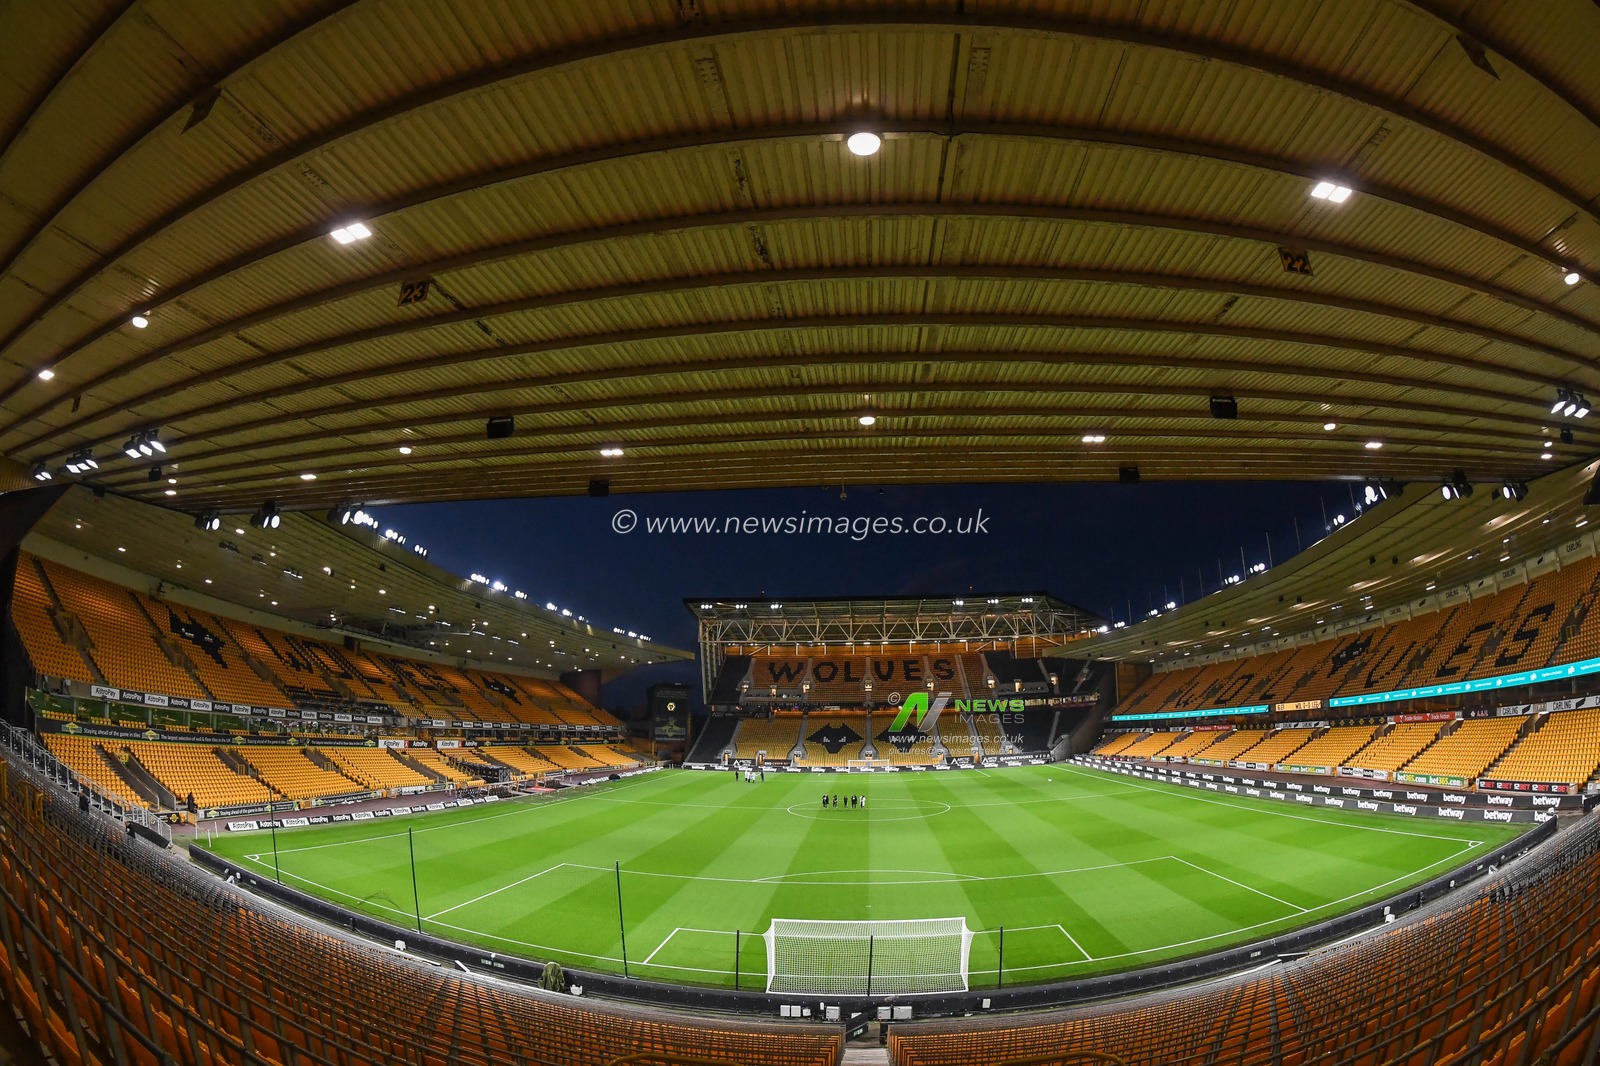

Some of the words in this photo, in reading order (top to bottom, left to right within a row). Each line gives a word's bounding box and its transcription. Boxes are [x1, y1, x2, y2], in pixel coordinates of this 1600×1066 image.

[1283, 252, 1310, 274] 22
[401, 281, 427, 304] 23
[768, 658, 955, 682] WOLVES
[95, 687, 116, 698] AstroPay
[122, 691, 143, 702] AstroPay
[148, 695, 166, 705] AstroPay
[170, 698, 189, 708] AstroPay
[193, 701, 210, 710] AstroPay
[214, 704, 230, 712] AstroPay
[234, 706, 250, 714] AstroPay
[1553, 701, 1571, 710] CARLING
[1502, 707, 1518, 715] CARLING
[1242, 778, 1255, 786] betway
[1397, 772, 1426, 783] bet365.com
[1429, 775, 1461, 786] bet365.com
[1225, 785, 1238, 793] betway
[1263, 780, 1277, 789] betway
[1286, 782, 1302, 791] betway
[1313, 785, 1330, 794] betway
[1514, 782, 1530, 790] 12BET
[1532, 783, 1549, 791] 12BET
[1551, 785, 1569, 793] 12BET
[1246, 787, 1260, 797] betway
[1269, 790, 1285, 800] betway
[1342, 787, 1360, 797] betway
[1373, 789, 1393, 799] betway
[1407, 791, 1428, 802] betway
[1295, 793, 1313, 804] betway
[1325, 797, 1344, 807] betway
[1443, 793, 1465, 804] betway
[1487, 795, 1513, 806] betway
[1532, 795, 1560, 807] betway
[1357, 800, 1378, 811] betway
[1394, 803, 1417, 816] betway
[1438, 807, 1464, 819] betway
[1483, 809, 1513, 822] betway
[1534, 810, 1554, 822] betw
[232, 821, 255, 829] AstroPay
[286, 817, 306, 825] AstroPay
